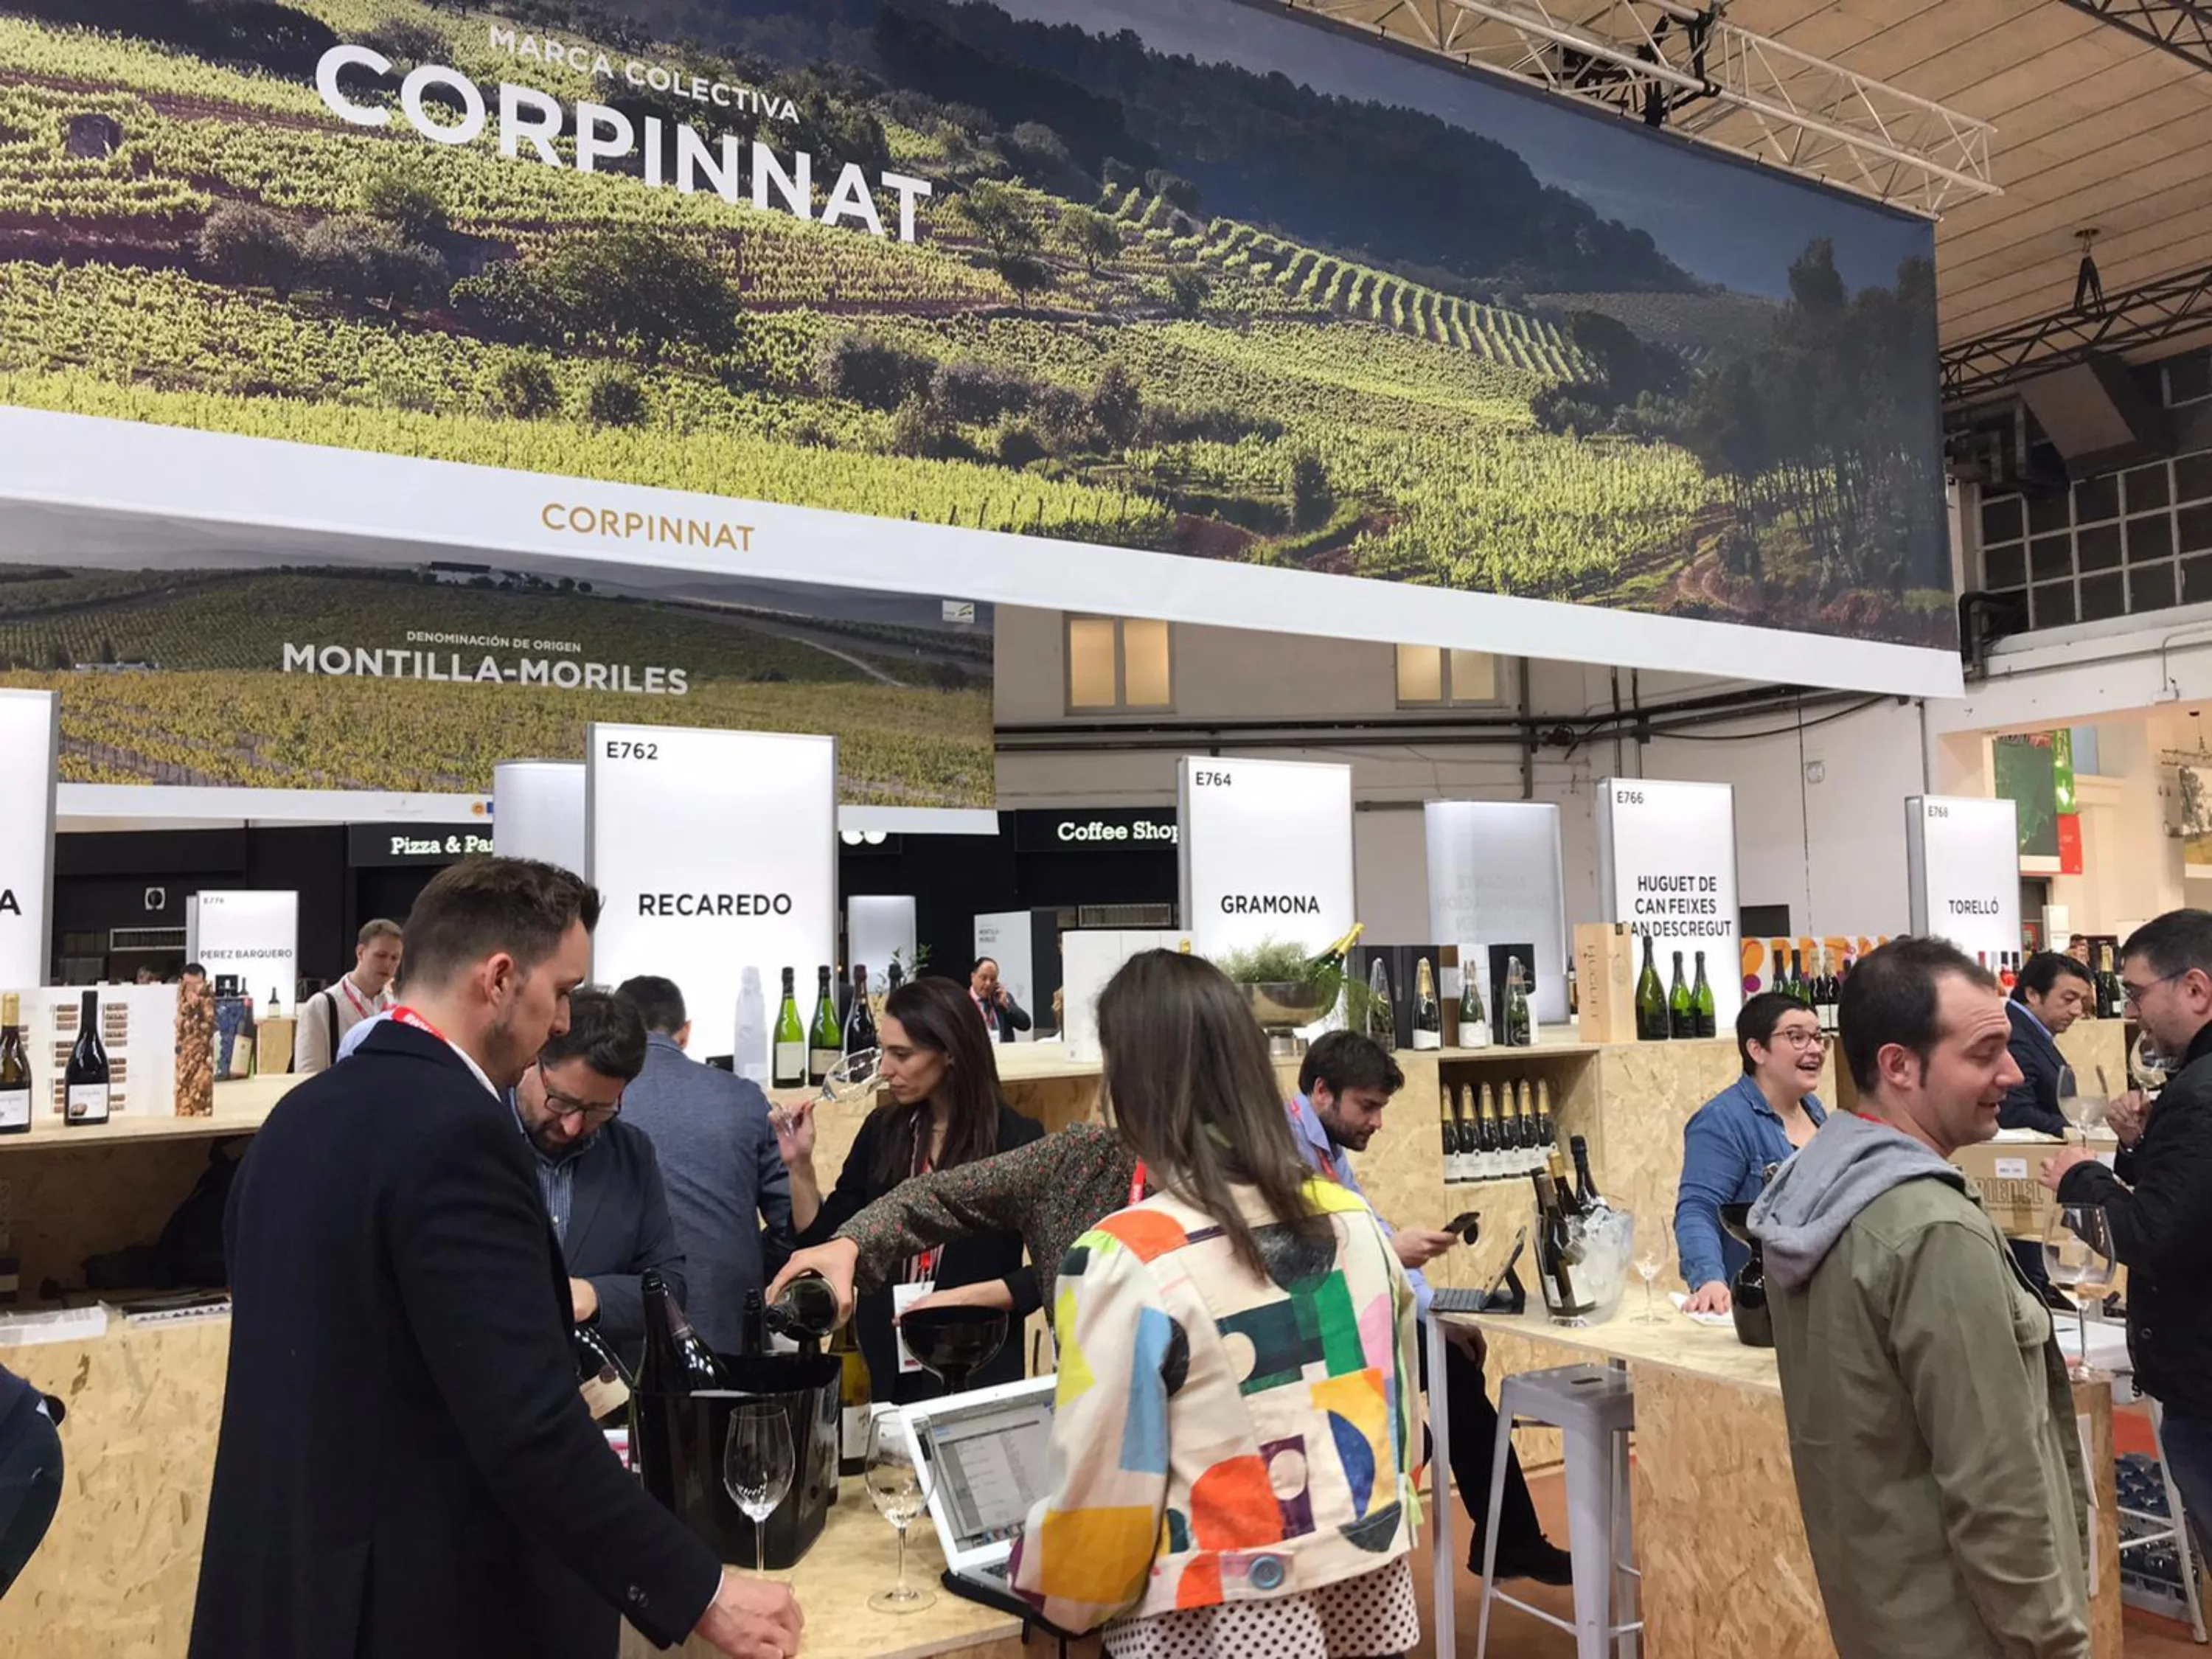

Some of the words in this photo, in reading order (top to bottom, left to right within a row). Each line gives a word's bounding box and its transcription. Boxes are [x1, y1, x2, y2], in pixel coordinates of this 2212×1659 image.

[489, 24, 613, 79] MARCA
[625, 61, 800, 124] COLECTIVA
[315, 44, 932, 243] CORPINNAT
[541, 504, 756, 552] CORPINNAT
[406, 630, 510, 648] DENOMINACIÓN
[512, 638, 530, 650] DE
[532, 639, 582, 653] ORIGEN
[282, 641, 689, 696] MONTILLA-MORILES
[607, 741, 658, 760] E762
[1196, 771, 1232, 787] E764
[1617, 790, 1644, 804] E766
[1057, 821, 1128, 841] Coffee
[391, 836, 442, 855] Pizza
[445, 835, 462, 853] &
[1638, 875, 1696, 892] HUGUET
[1698, 876, 1717, 892] DE
[639, 893, 793, 917] RECAREDO
[1220, 894, 1321, 914] GRAMONA
[1635, 897, 1666, 915] CAN
[1669, 898, 1717, 915] FEIXES
[1948, 896, 2000, 915] TORELLÓ
[1627, 920, 1651, 936] AN
[1653, 921, 1732, 937] DESCREGUT
[200, 949, 234, 959] PEREZ
[235, 948, 293, 959] BARQUERO
